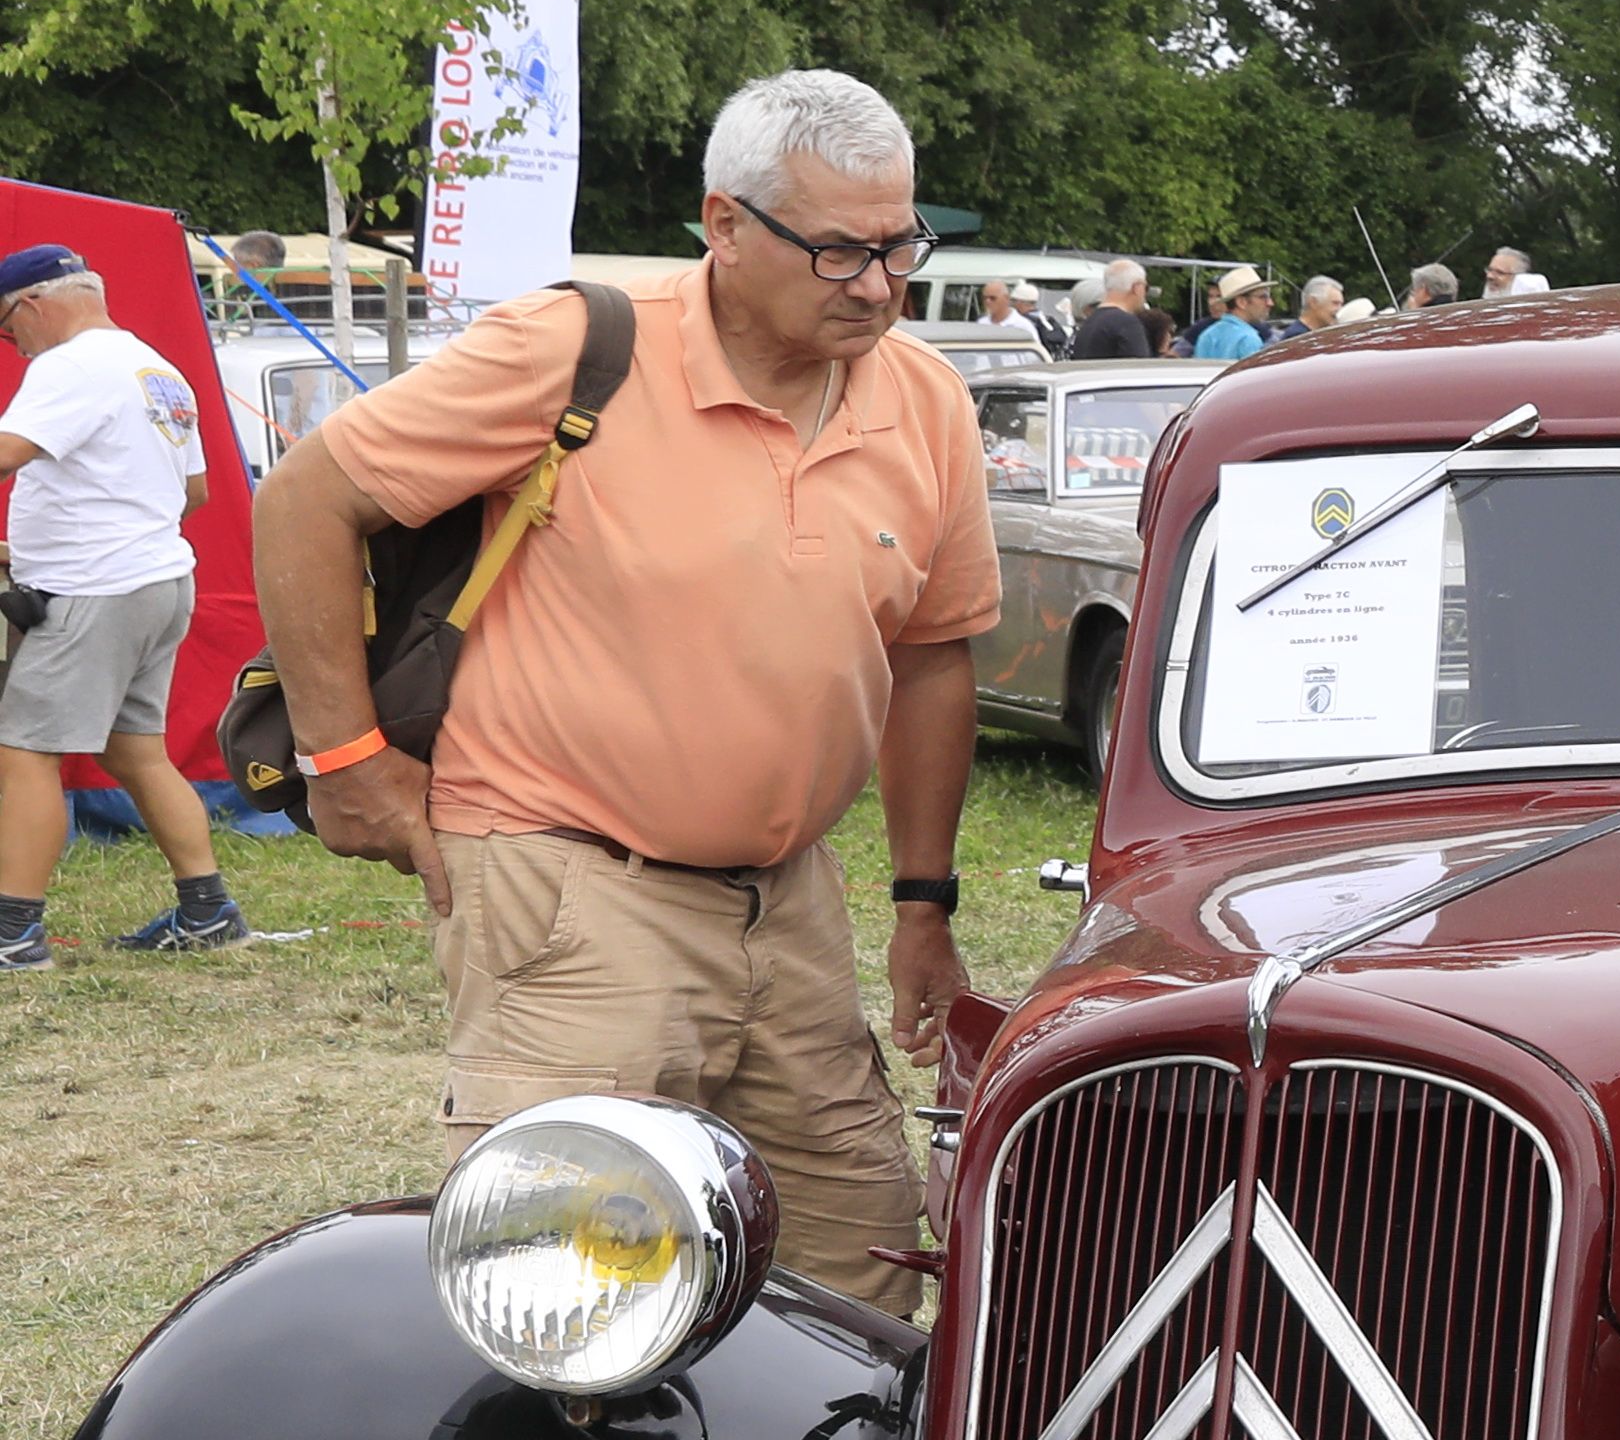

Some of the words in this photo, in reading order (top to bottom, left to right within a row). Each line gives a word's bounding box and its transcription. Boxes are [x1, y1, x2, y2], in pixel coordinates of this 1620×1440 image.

[1369, 559, 1408, 569] AVANT
[1303, 592, 1331, 602] Type
[1336, 591, 1350, 599] 7C
[1267, 609, 1275, 617] 4
[1278, 608, 1333, 617] cylindres
[1354, 605, 1385, 614] ligne
[1289, 635, 1326, 645] année
[1330, 634, 1359, 643] 1936
